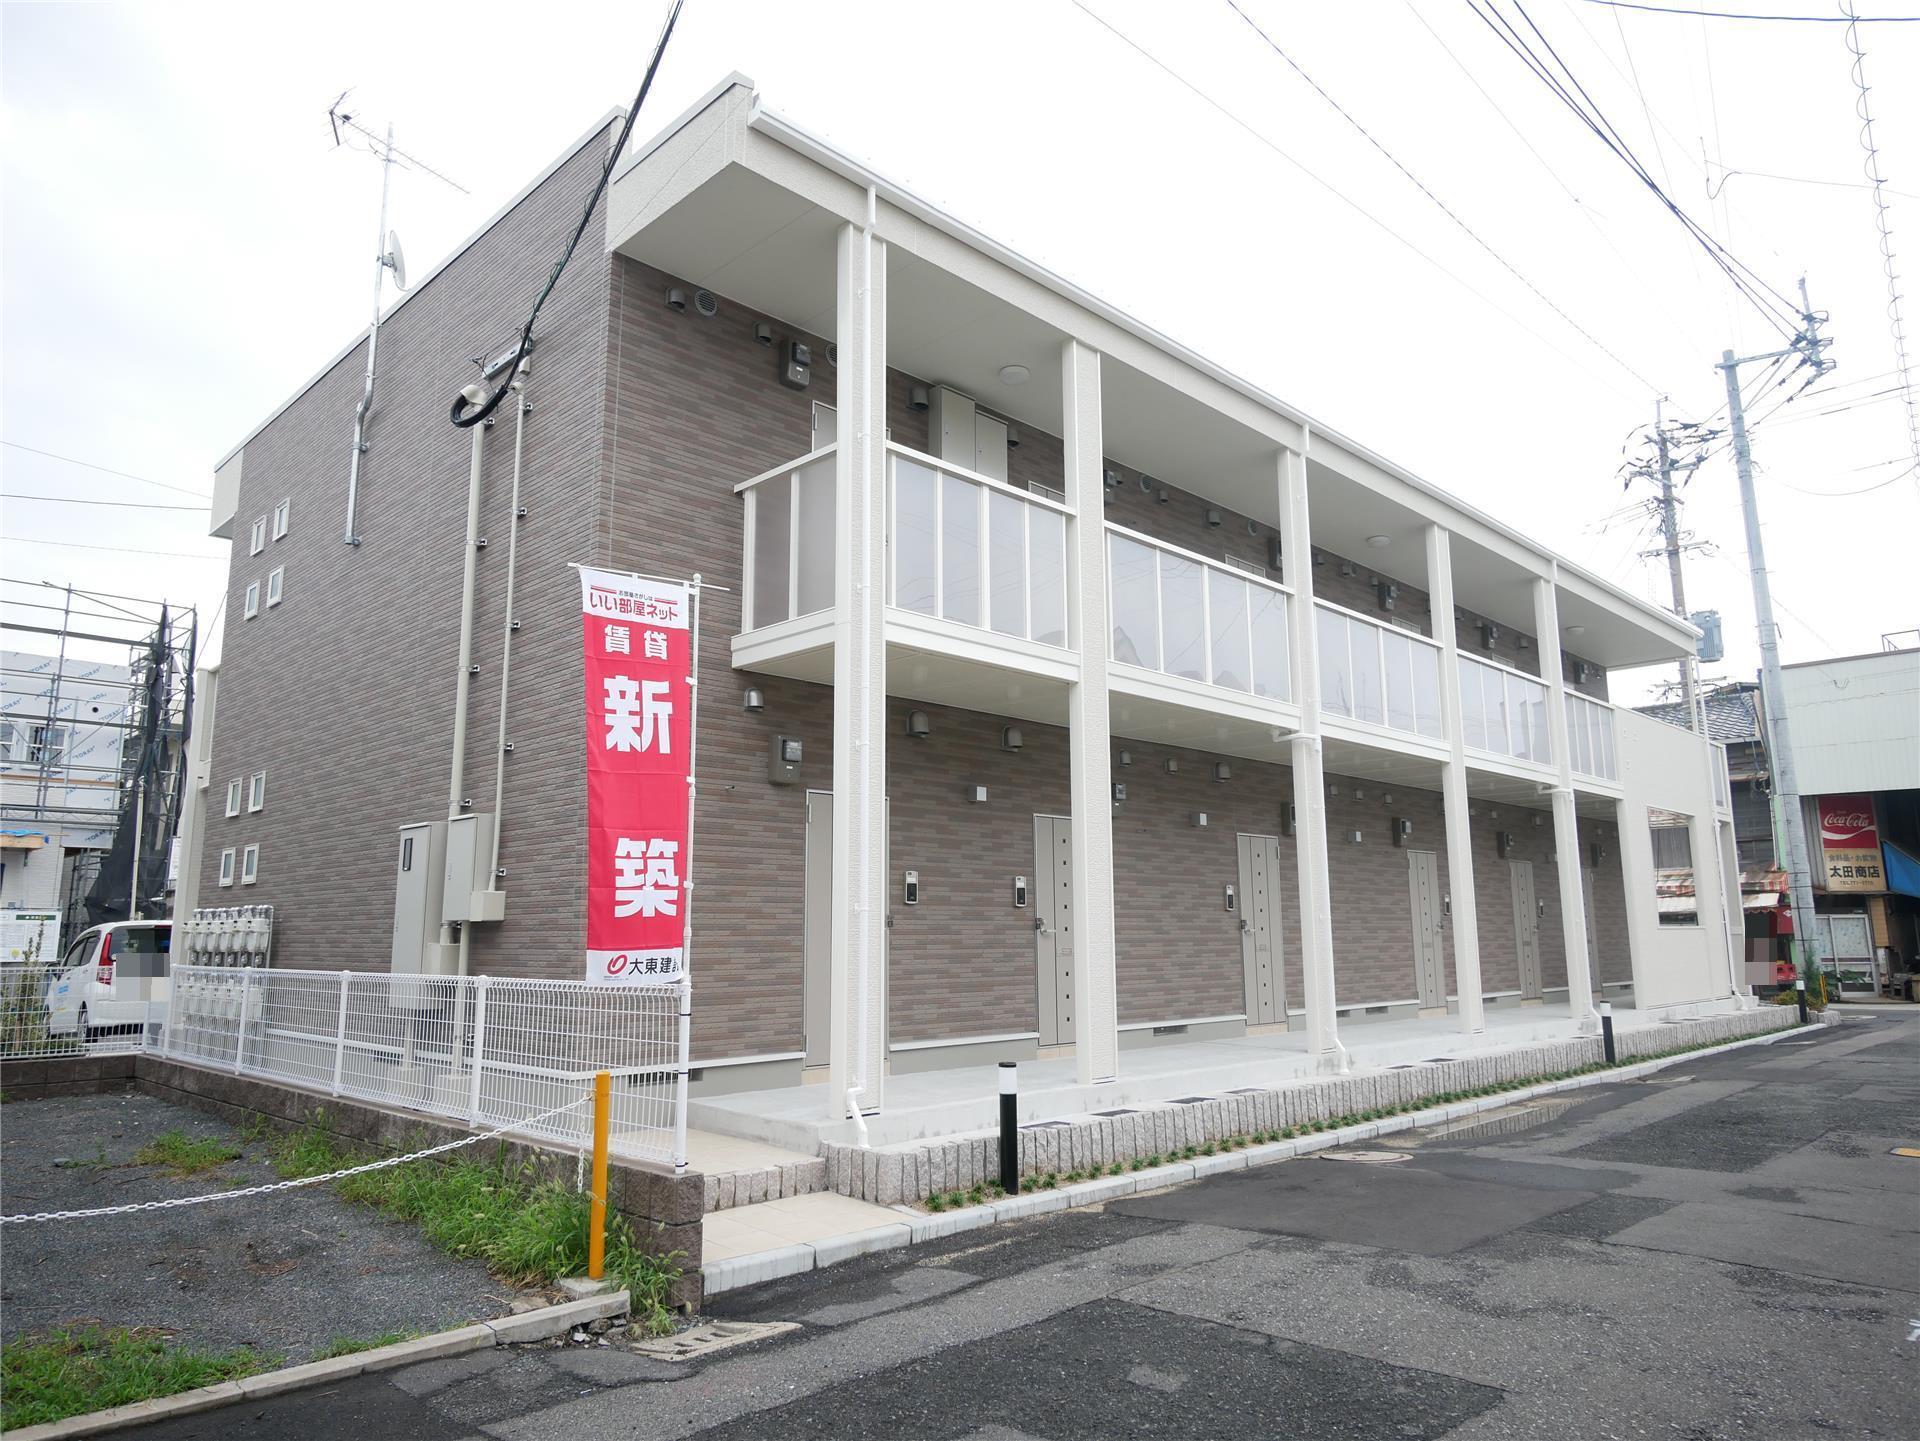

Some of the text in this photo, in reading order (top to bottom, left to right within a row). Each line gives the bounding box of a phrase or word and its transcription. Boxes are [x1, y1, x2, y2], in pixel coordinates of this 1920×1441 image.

[590, 592, 678, 621] いい部屋ネット
[604, 624, 668, 660] 賃貸
[1824, 813, 1869, 827] Coca-Cola
[1829, 866, 1880, 878] 太田商店
